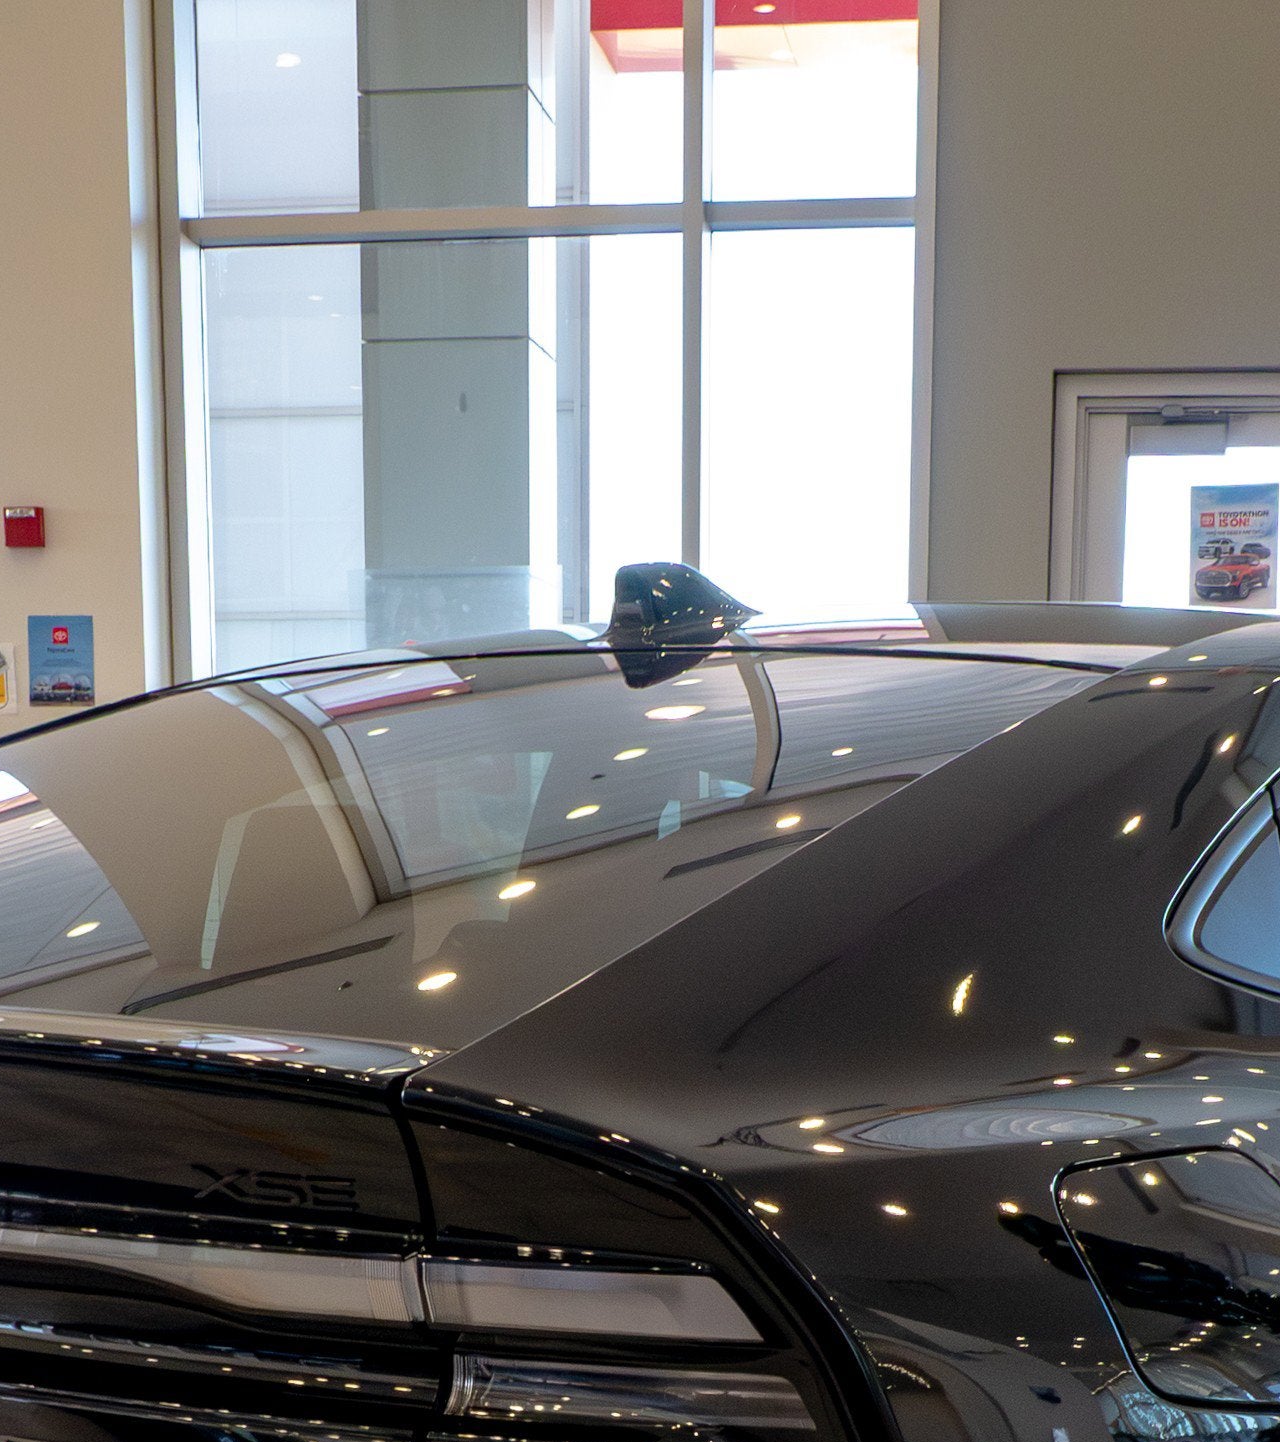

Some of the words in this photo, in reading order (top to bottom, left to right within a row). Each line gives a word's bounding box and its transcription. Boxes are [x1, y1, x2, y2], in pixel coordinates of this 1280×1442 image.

[1218, 510, 1270, 518] TOYOTATHON
[1218, 518, 1229, 528] IS
[1229, 518, 1250, 528] ON!
[190, 1162, 361, 1212] XSE
